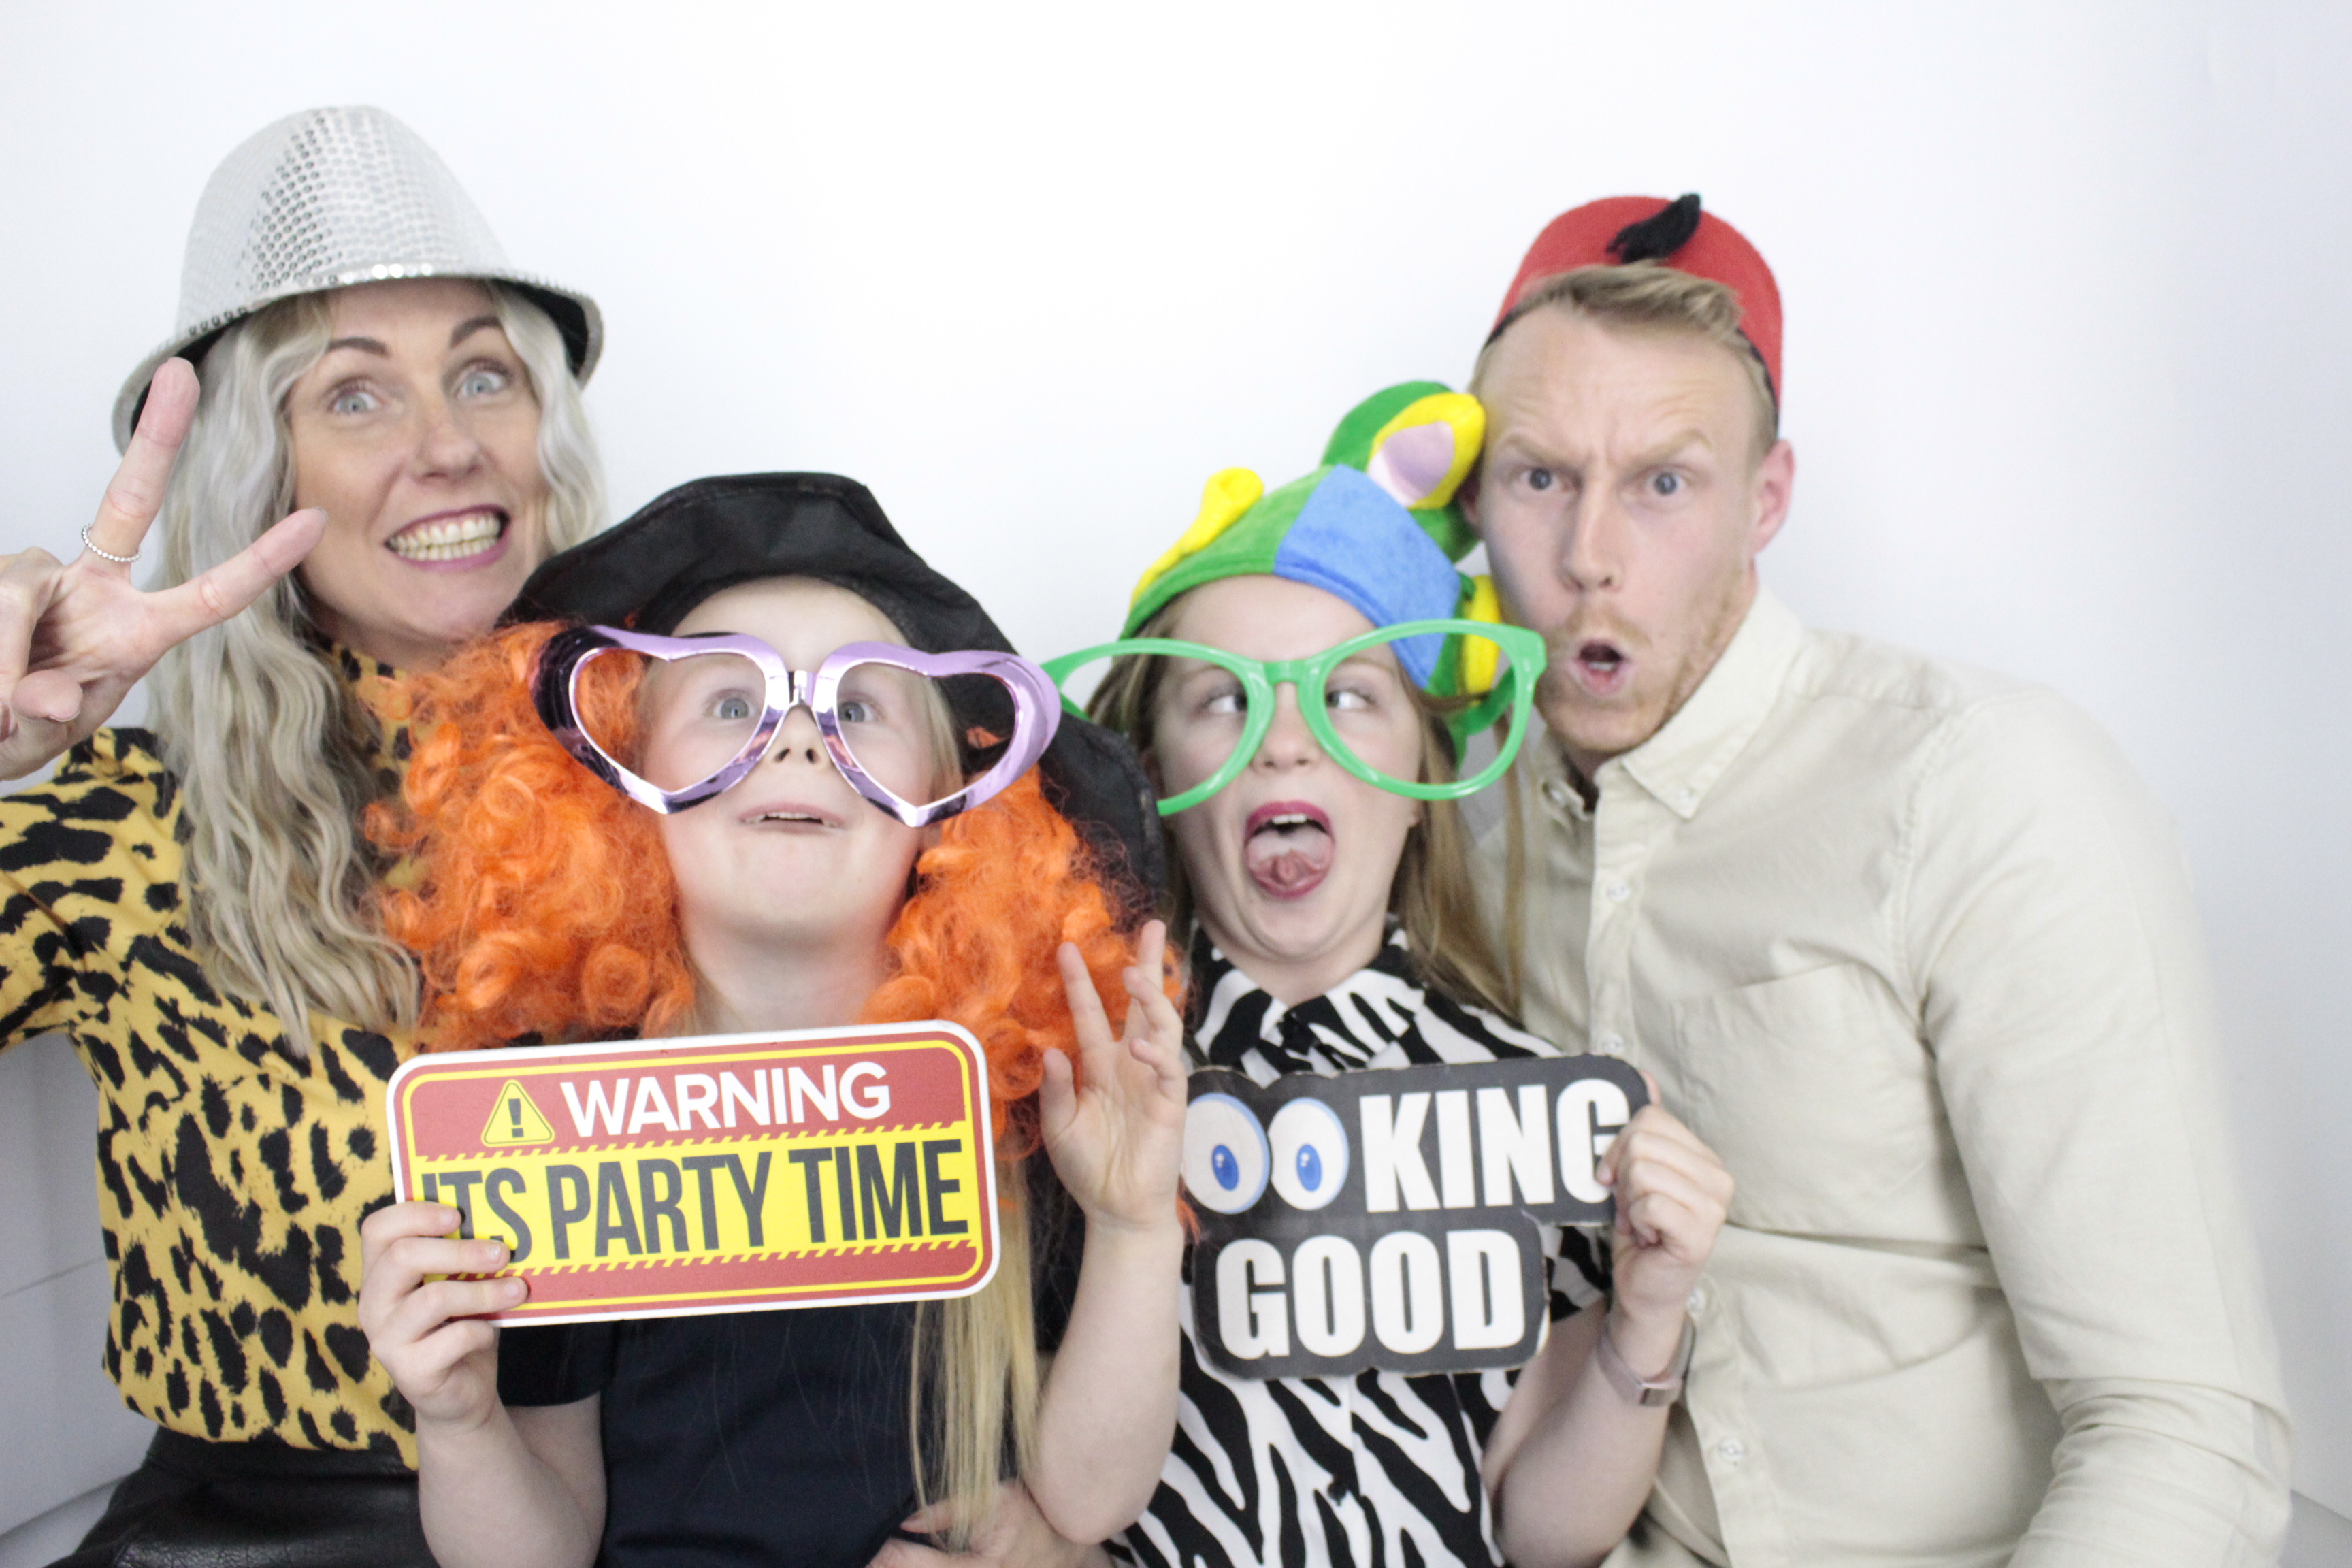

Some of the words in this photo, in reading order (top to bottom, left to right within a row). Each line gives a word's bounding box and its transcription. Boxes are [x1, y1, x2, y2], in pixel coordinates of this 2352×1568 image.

[559, 1061, 891, 1138] WARNING
[545, 1151, 772, 1260] PARTY
[788, 1139, 968, 1243] TIME
[1217, 1230, 1525, 1360] GOOD
